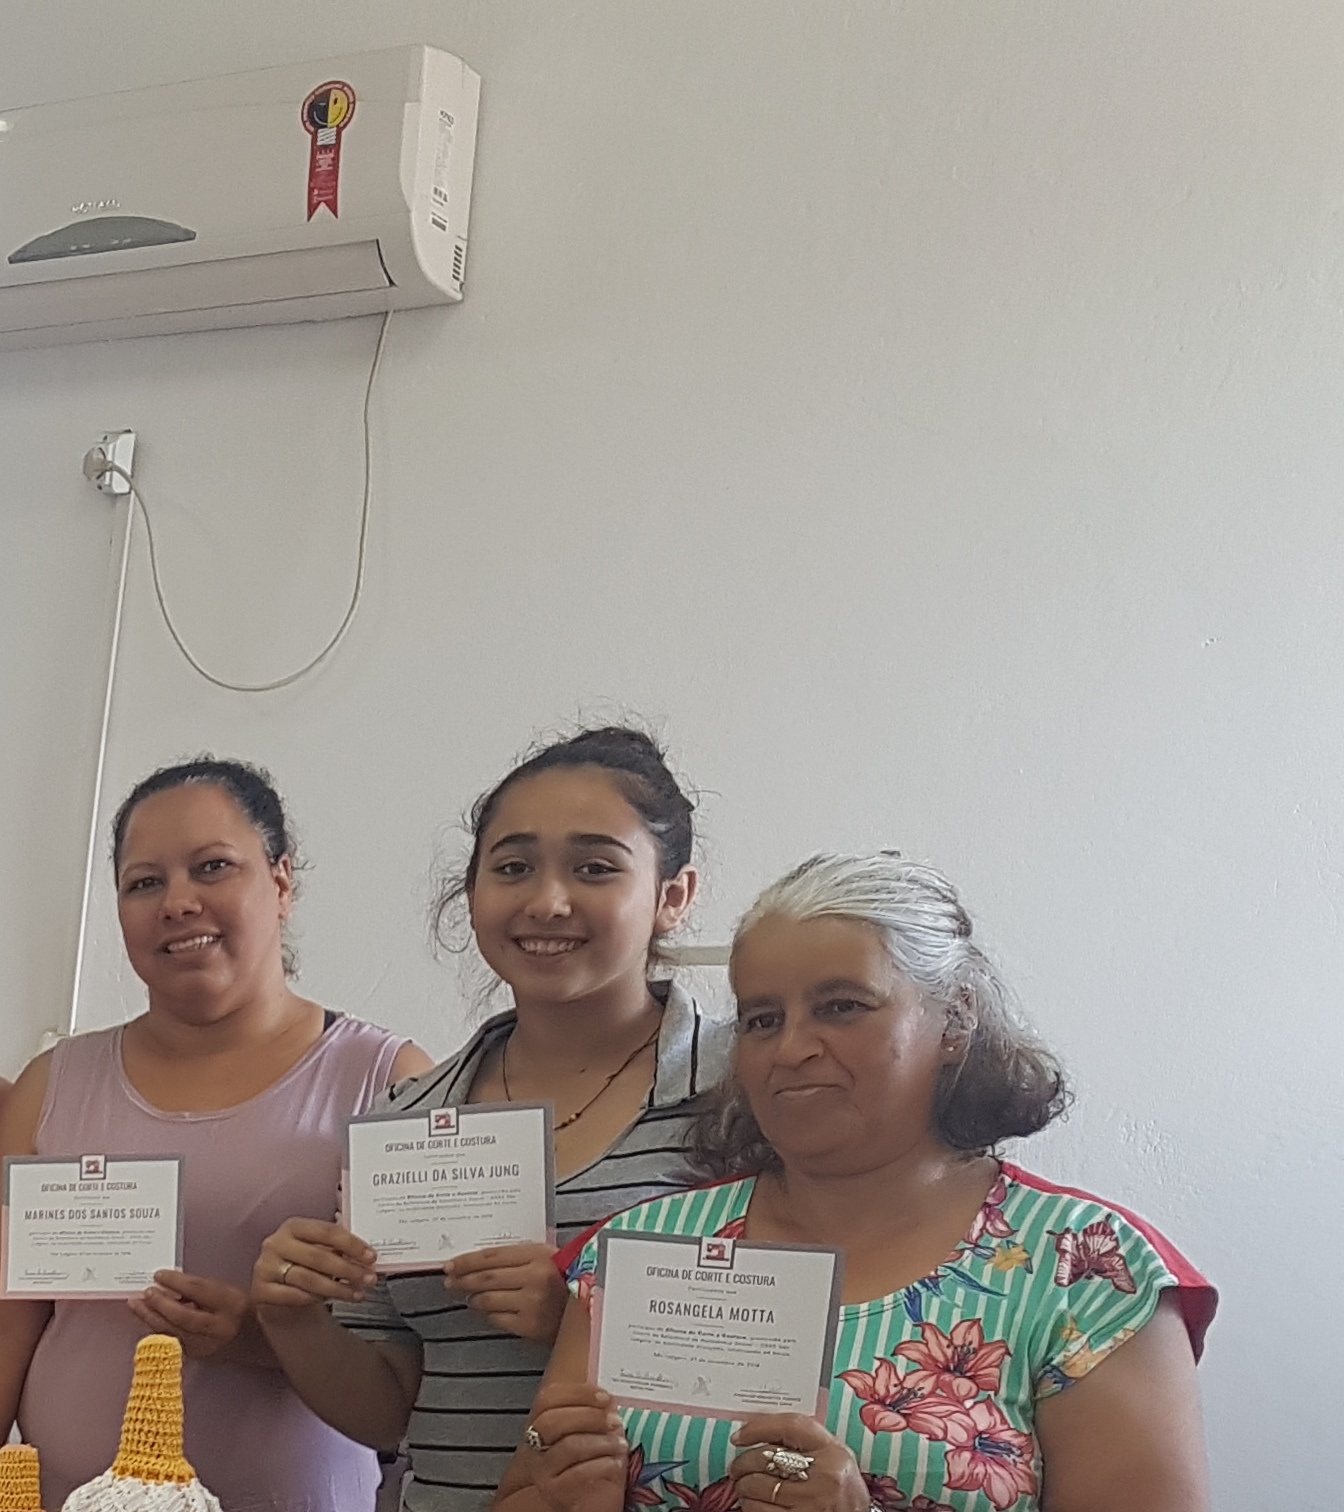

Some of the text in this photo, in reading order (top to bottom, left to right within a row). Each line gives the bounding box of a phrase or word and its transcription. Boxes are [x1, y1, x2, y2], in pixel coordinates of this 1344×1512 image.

[385, 1136, 496, 1152] OFICINA DE CORTE E COSTURA
[373, 1164, 519, 1186] GRAZIELLI DA SILVA JUNG
[25, 1208, 160, 1220] MARINES DOS SANTOS SOUZA
[646, 1266, 775, 1287] OFICINA DE CORTE E COSTURA
[649, 1300, 775, 1323] ROSANGELA MOTTA
